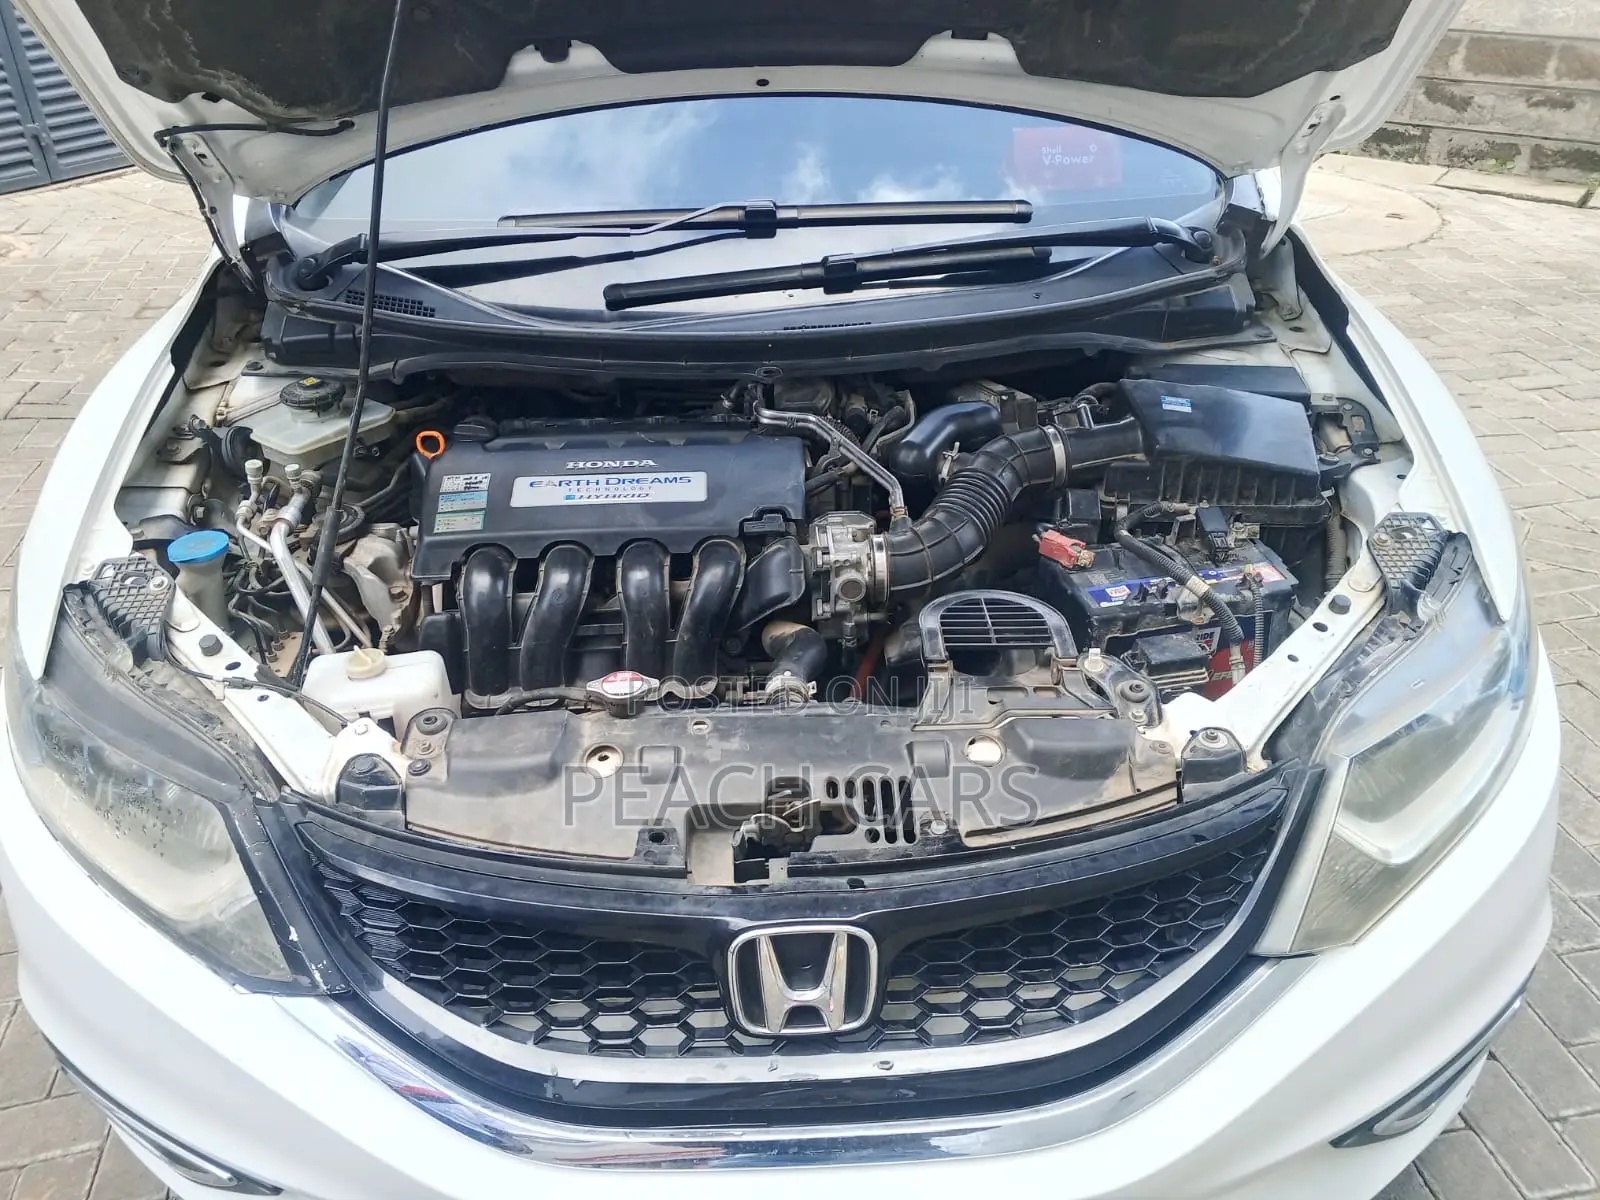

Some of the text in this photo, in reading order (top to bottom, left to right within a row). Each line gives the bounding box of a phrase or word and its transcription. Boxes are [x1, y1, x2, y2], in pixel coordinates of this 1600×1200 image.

[1042, 144, 1062, 154] Shell
[1043, 155, 1095, 166] V-Power
[565, 459, 658, 470] HONDA
[529, 476, 692, 488] EARTH DREAMS
